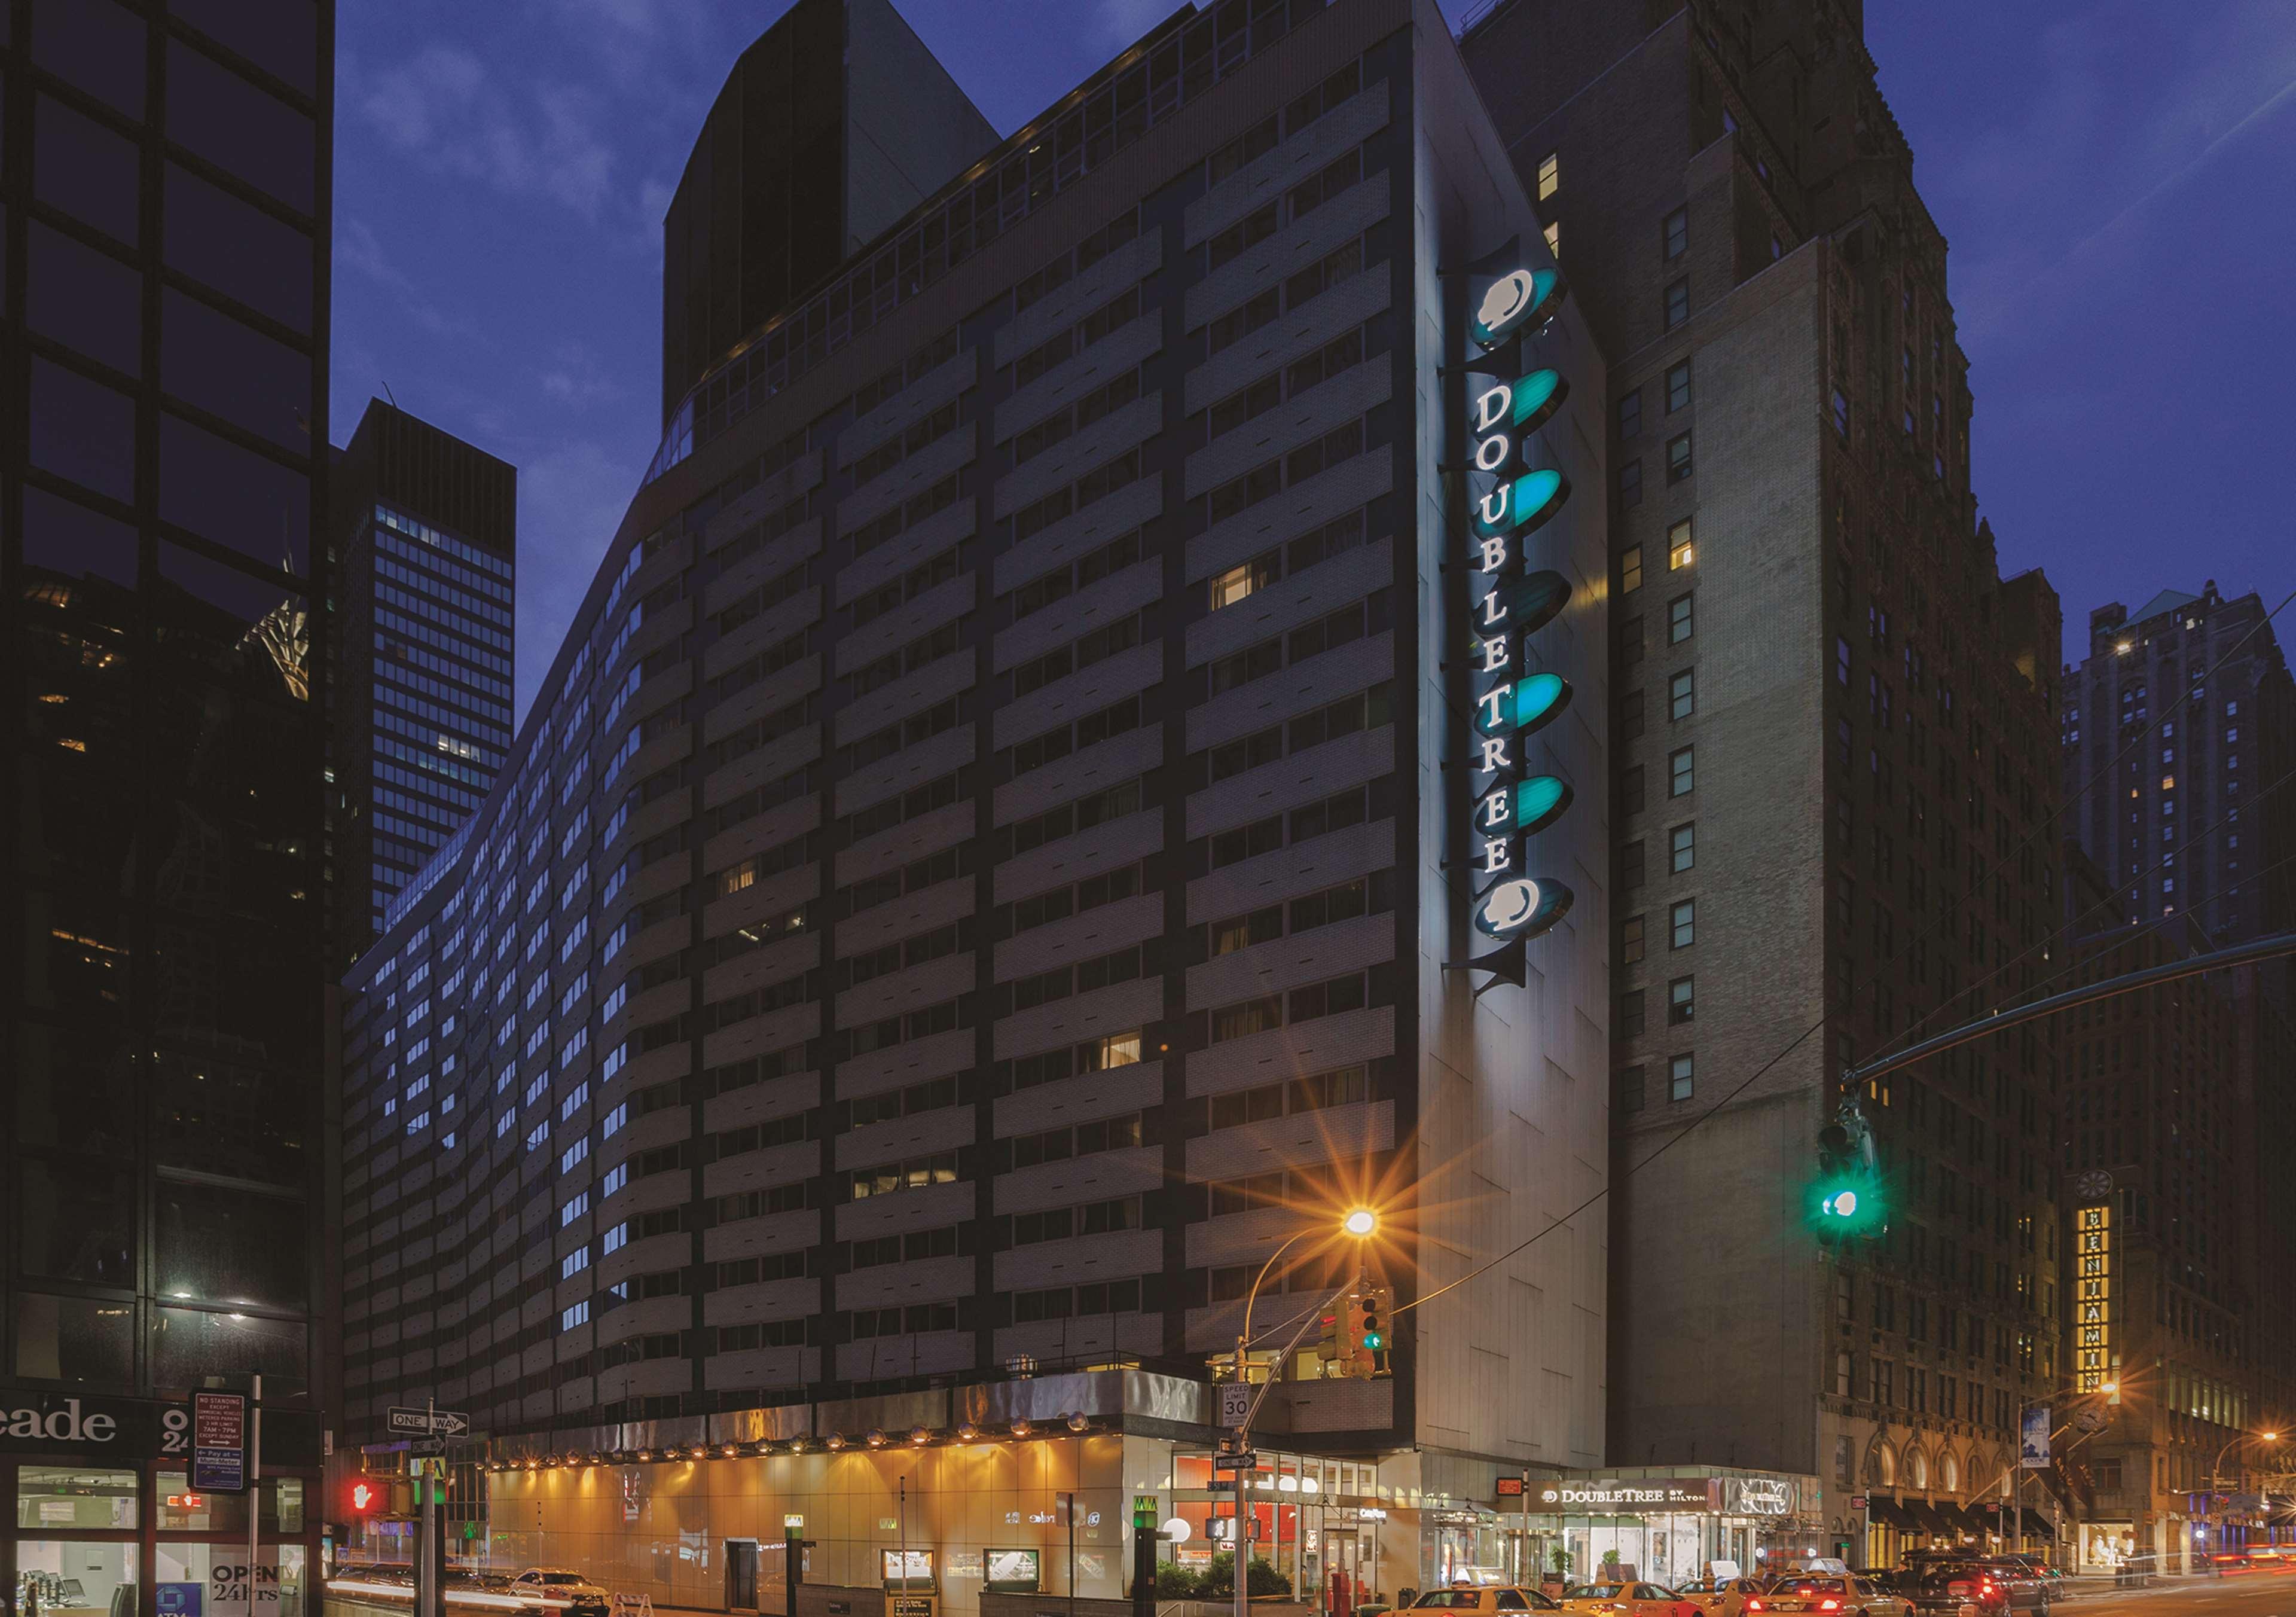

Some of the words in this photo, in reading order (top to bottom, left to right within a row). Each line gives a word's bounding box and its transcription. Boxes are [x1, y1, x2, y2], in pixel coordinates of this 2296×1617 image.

[1476, 385, 1511, 874] DOUBLETREE
[2086, 1213, 2100, 1387] BENJAMIN
[0, 1399, 117, 1441] ade
[396, 1415, 421, 1426] ONE
[435, 1419, 460, 1429] WAY
[1225, 1401, 1247, 1415] 30
